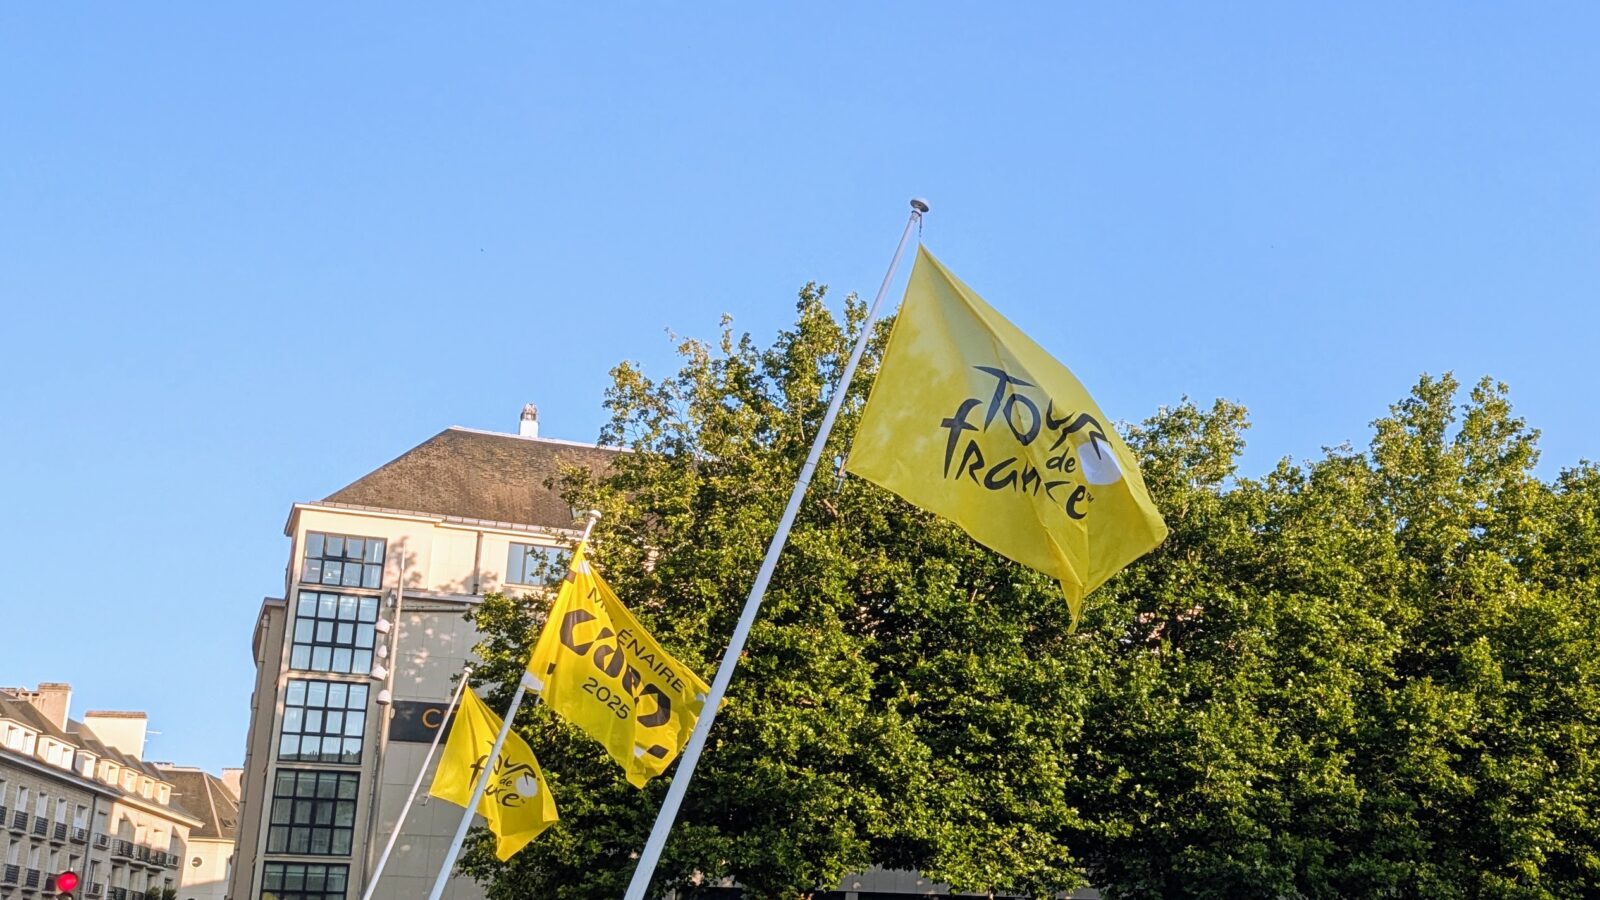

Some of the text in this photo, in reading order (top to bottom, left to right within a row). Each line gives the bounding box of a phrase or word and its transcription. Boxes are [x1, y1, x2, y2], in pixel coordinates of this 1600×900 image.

[1045, 447, 1077, 474] de
[581, 676, 631, 720] 2025
[499, 776, 513, 787] de
